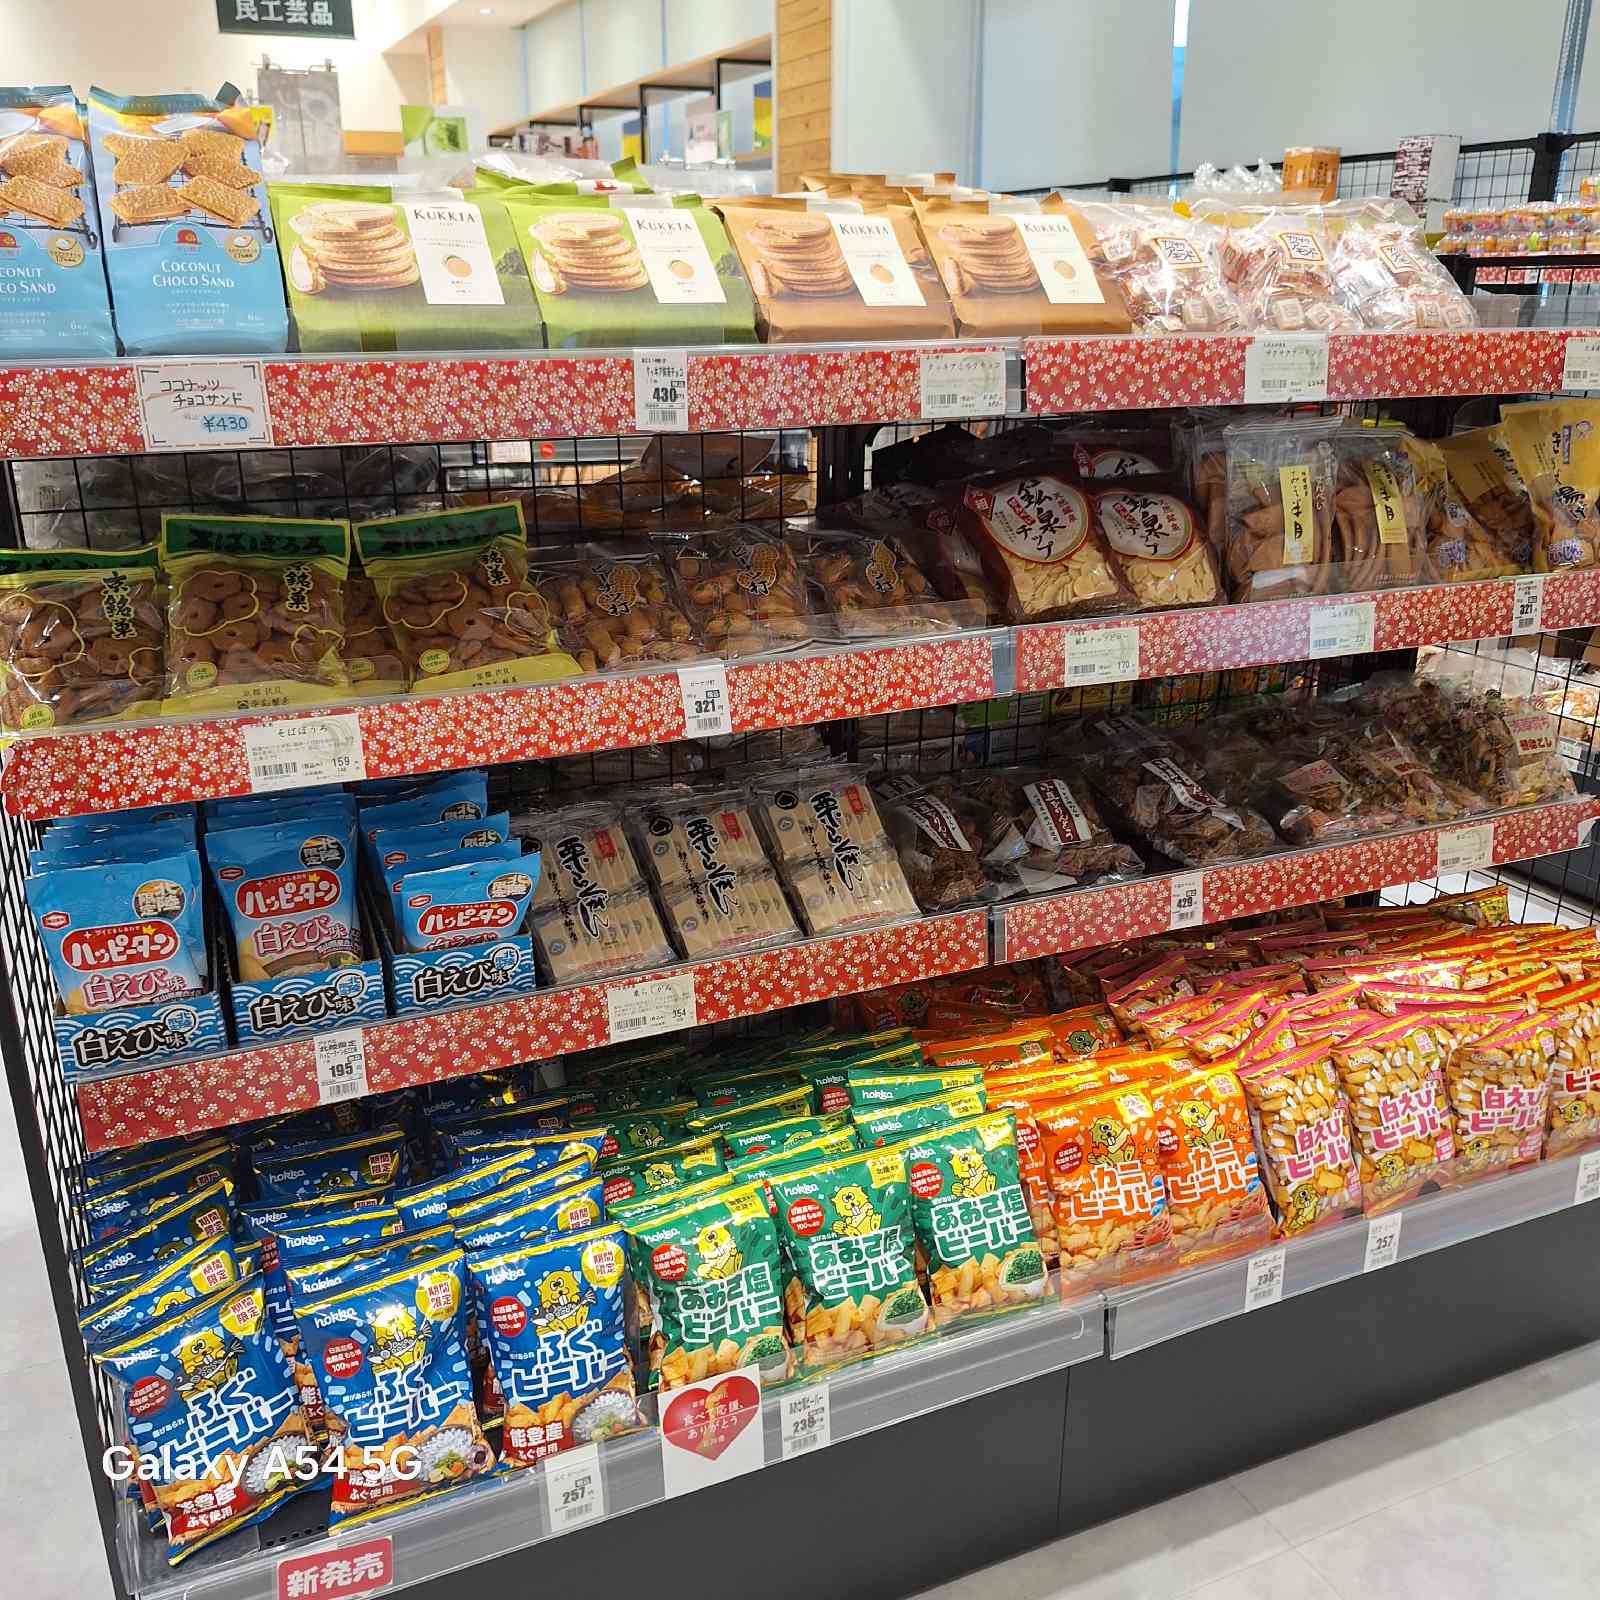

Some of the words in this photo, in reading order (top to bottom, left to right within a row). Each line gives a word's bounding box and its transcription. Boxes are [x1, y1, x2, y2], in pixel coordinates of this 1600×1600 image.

[235, 0, 333, 26] 民工芸品
[413, 209, 476, 224] KUKKIA
[637, 218, 692, 232] KUKKIA
[840, 223, 889, 236] KUKKIA
[1023, 222, 1069, 234] KUKKIA
[161, 260, 222, 273] COCONUT
[20, 283, 57, 294] SAND
[152, 274, 198, 288] CHOCO
[201, 274, 235, 288] SAND
[160, 379, 220, 393] ココナッツ
[653, 387, 677, 402] 430
[173, 392, 243, 408] チョコサンド
[1520, 604, 1533, 615] 321
[695, 699, 716, 713] 321
[333, 757, 350, 769] 159
[256, 914, 348, 957] 白えび味
[86, 968, 187, 1006] 白えび味
[414, 960, 511, 1004] 白えび味
[250, 986, 356, 1034] 白えび味
[75, 1020, 188, 1067] 白えび味
[329, 1063, 353, 1077] 195
[815, 1075, 846, 1086] hokka
[862, 1089, 895, 1100] hokka
[1481, 1084, 1547, 1113] 白えび
[1379, 1083, 1438, 1126] 白えび
[1296, 1111, 1342, 1151] 白えび
[1371, 1106, 1451, 1151] ビーバー
[739, 1133, 772, 1146] hokka
[1188, 1139, 1234, 1173] カニ
[268, 1168, 305, 1183] hokka
[1090, 1160, 1147, 1195] カニ
[1167, 1162, 1261, 1203] ビーバー
[783, 1182, 820, 1198] hokka
[92, 1200, 130, 1219] hokka
[413, 1202, 448, 1220] hokka
[1070, 1182, 1166, 1221] ビーバー
[250, 1210, 288, 1226] hokka
[285, 1233, 325, 1249] hokka
[464, 1232, 503, 1250] hokka
[935, 1215, 1033, 1262] ビーバー
[1376, 1233, 1394, 1250] 257
[592, 1251, 614, 1266] 期間
[595, 1262, 617, 1277] 限定
[813, 1252, 912, 1300] ビーバー
[230, 1294, 255, 1315] 期間
[237, 1307, 261, 1326] 限定
[314, 1308, 357, 1328] hokka
[680, 1296, 781, 1343] ビーバー
[537, 1319, 602, 1366] ふぐ
[374, 1353, 432, 1406] ふぐ
[512, 1348, 627, 1401] ビーバー
[186, 1367, 256, 1431] ふぐ
[344, 1380, 462, 1442] ビーバー
[510, 1422, 564, 1448] 能登産
[349, 1485, 393, 1500] ふぐ使用
[562, 1487, 586, 1506] 257
[287, 1552, 384, 1598] 新発売
